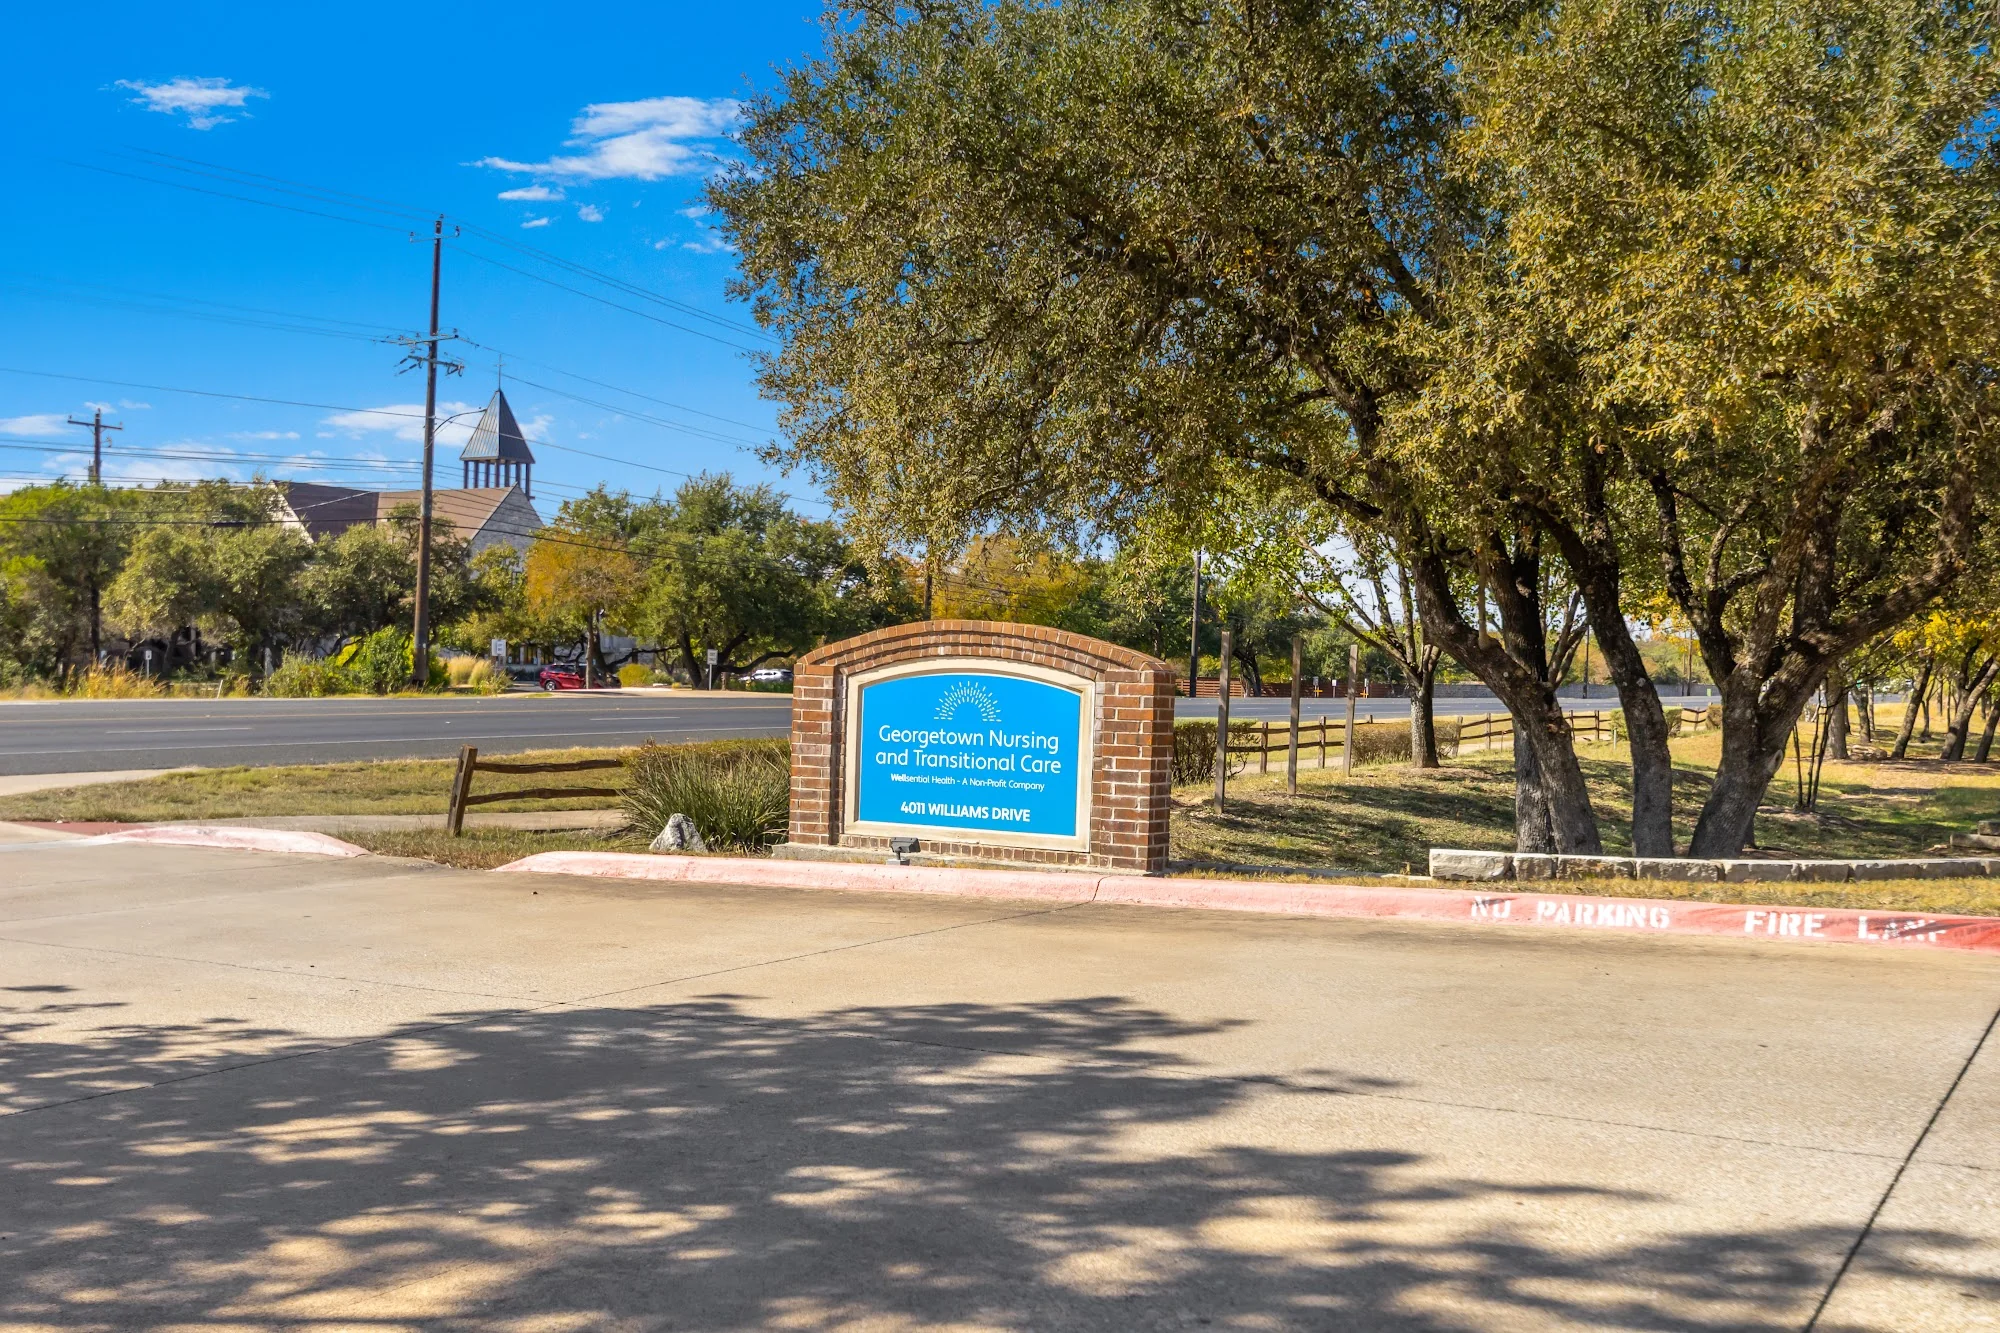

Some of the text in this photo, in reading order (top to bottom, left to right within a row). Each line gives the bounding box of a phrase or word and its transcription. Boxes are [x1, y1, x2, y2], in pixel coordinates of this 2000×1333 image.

[880, 725, 1059, 754] Georgetown Nursing
[876, 749, 1062, 774] and Transitional Care
[890, 773, 930, 784] Wellsential
[931, 776, 955, 785] Health
[962, 778, 969, 786] A
[969, 778, 1007, 788] Non-Profit
[1008, 780, 1045, 792] Company
[901, 801, 1031, 823] 4011 WILLIAMS DRIVE
[1471, 896, 1511, 918] NO
[1537, 900, 1670, 928] PARKING
[1744, 911, 1826, 937] FIRE
